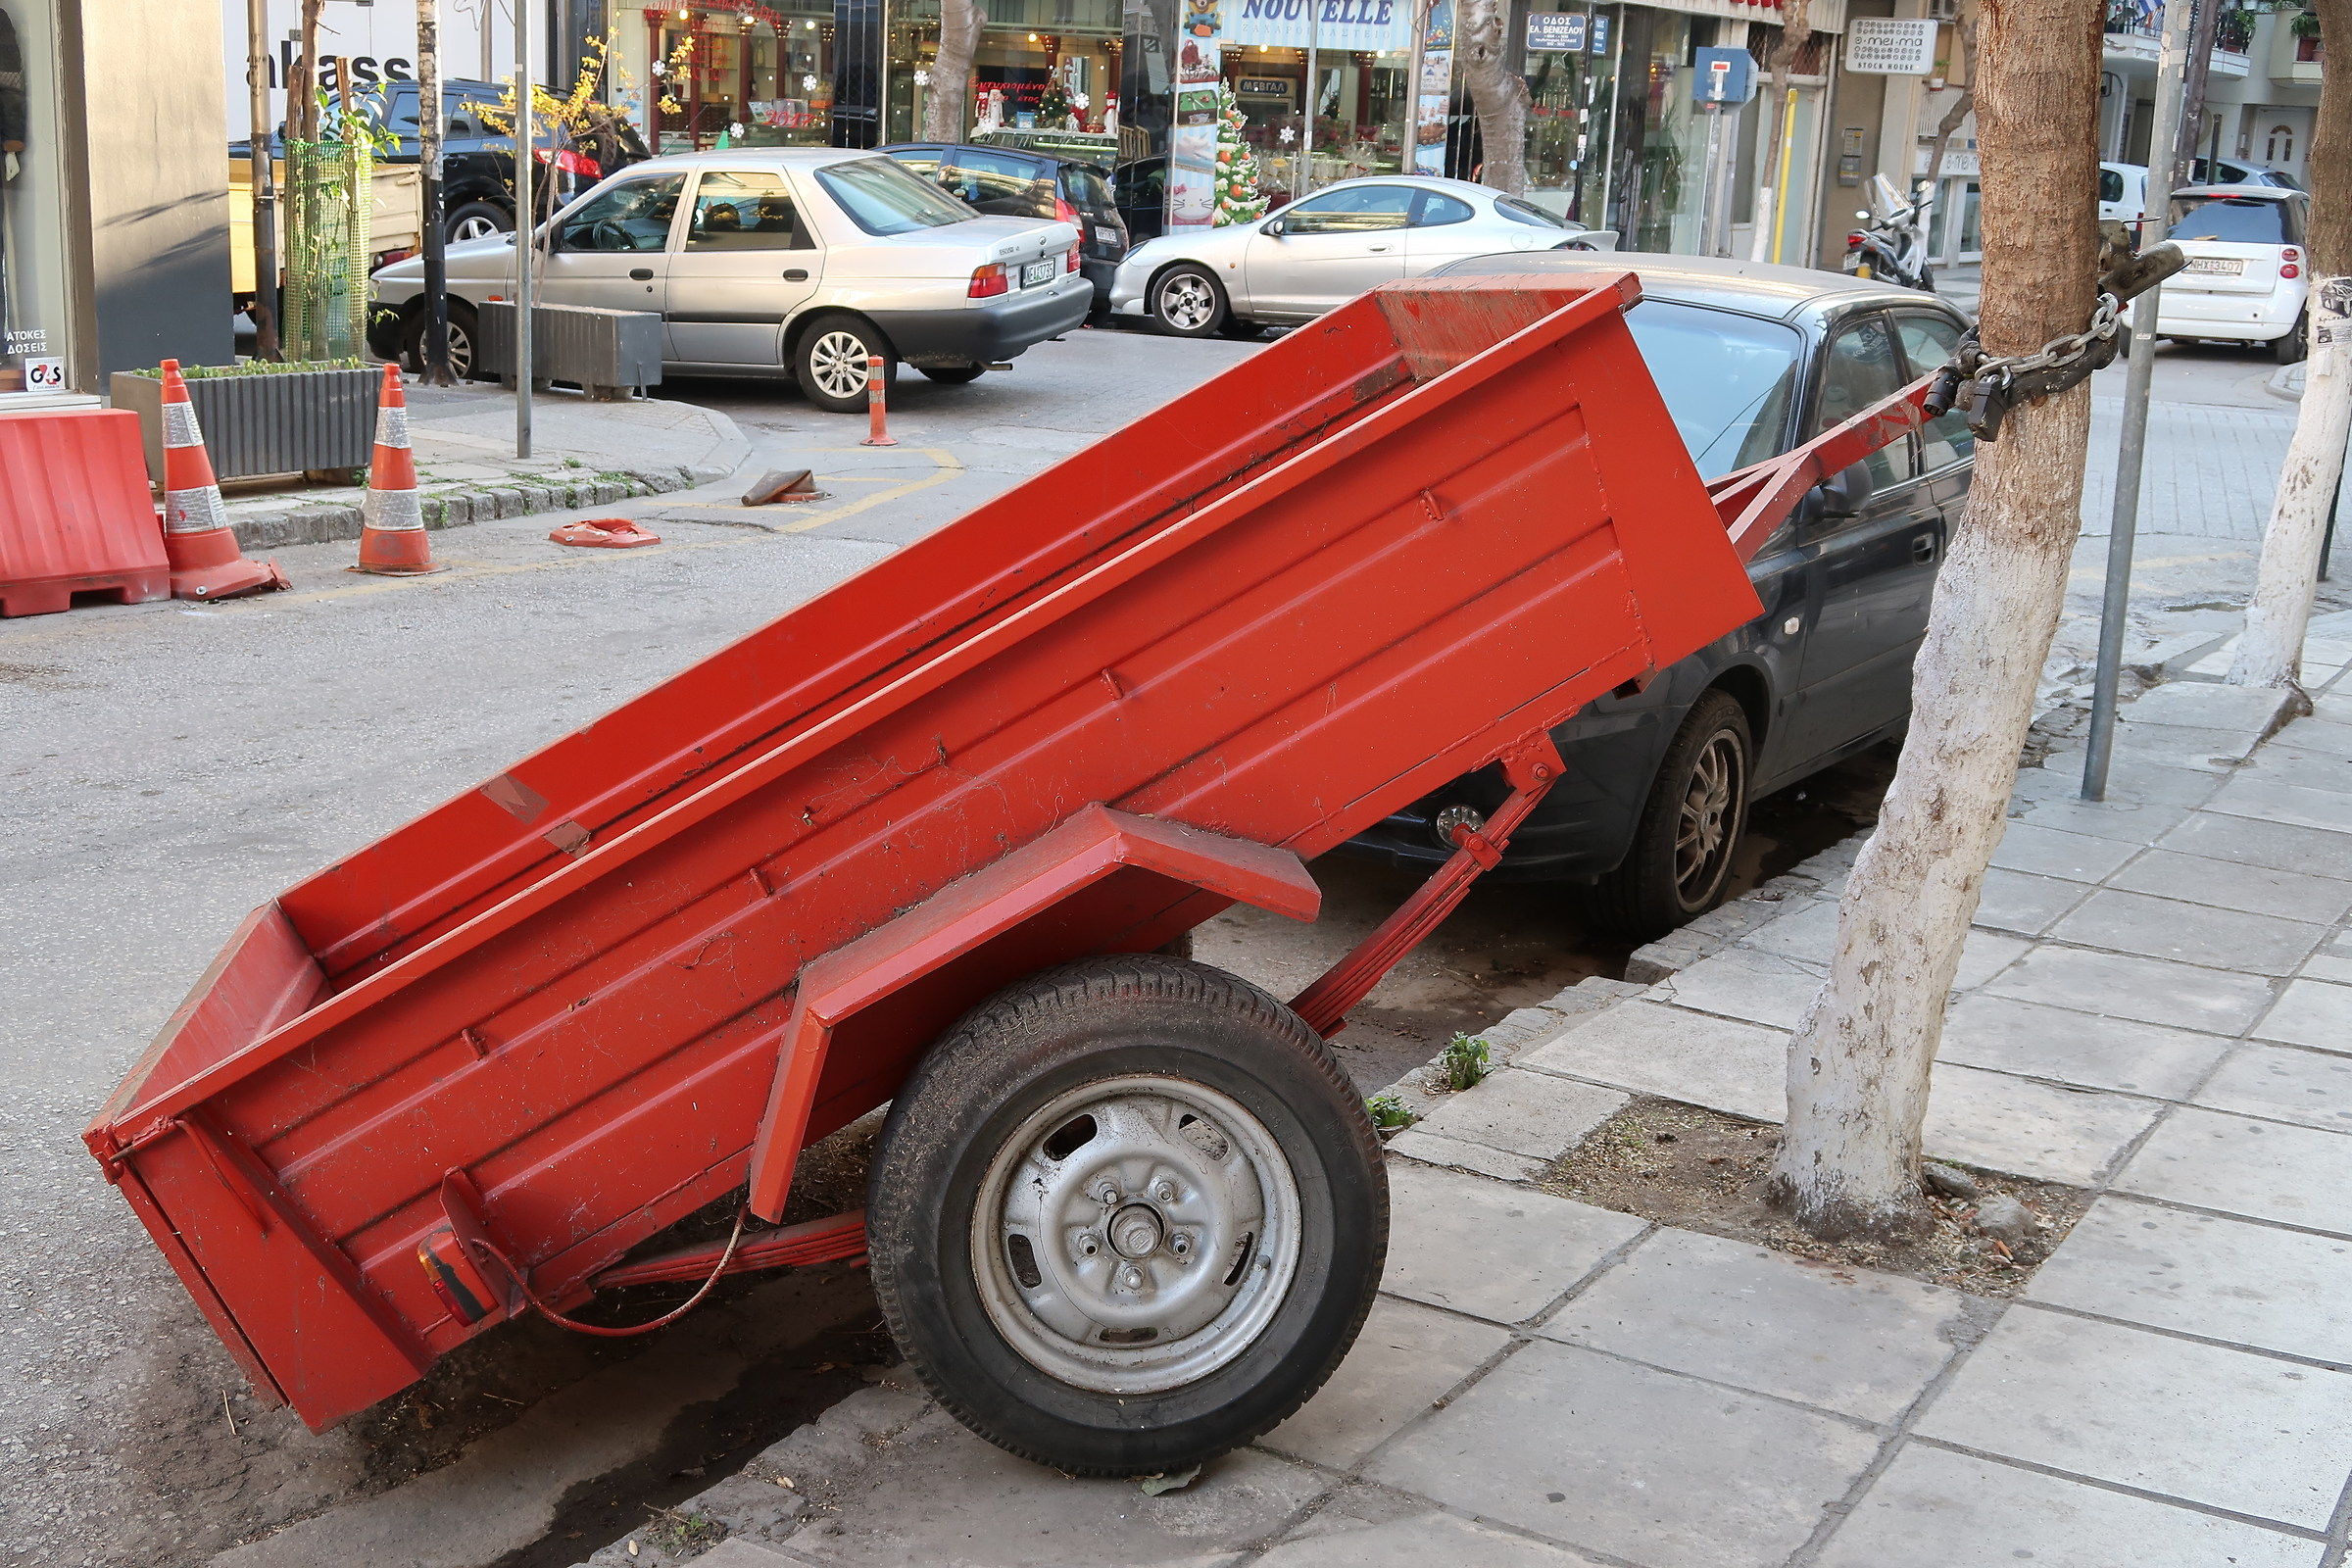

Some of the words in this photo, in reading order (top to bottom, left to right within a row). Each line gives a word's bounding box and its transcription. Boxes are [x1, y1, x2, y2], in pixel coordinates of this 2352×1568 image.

[1543, 17, 1572, 25] ΟΔΟΣ
[1544, 25, 1584, 34] ΒΕΝΙΖΕΛΟΥ
[1243, 80, 1286, 93] ΜΕΒΓΑΛ
[762, 109, 815, 129] 2017
[6, 329, 46, 341] ΑΤΟΚΕΣ
[7, 342, 47, 354] ΔΟΣΕΙΣ
